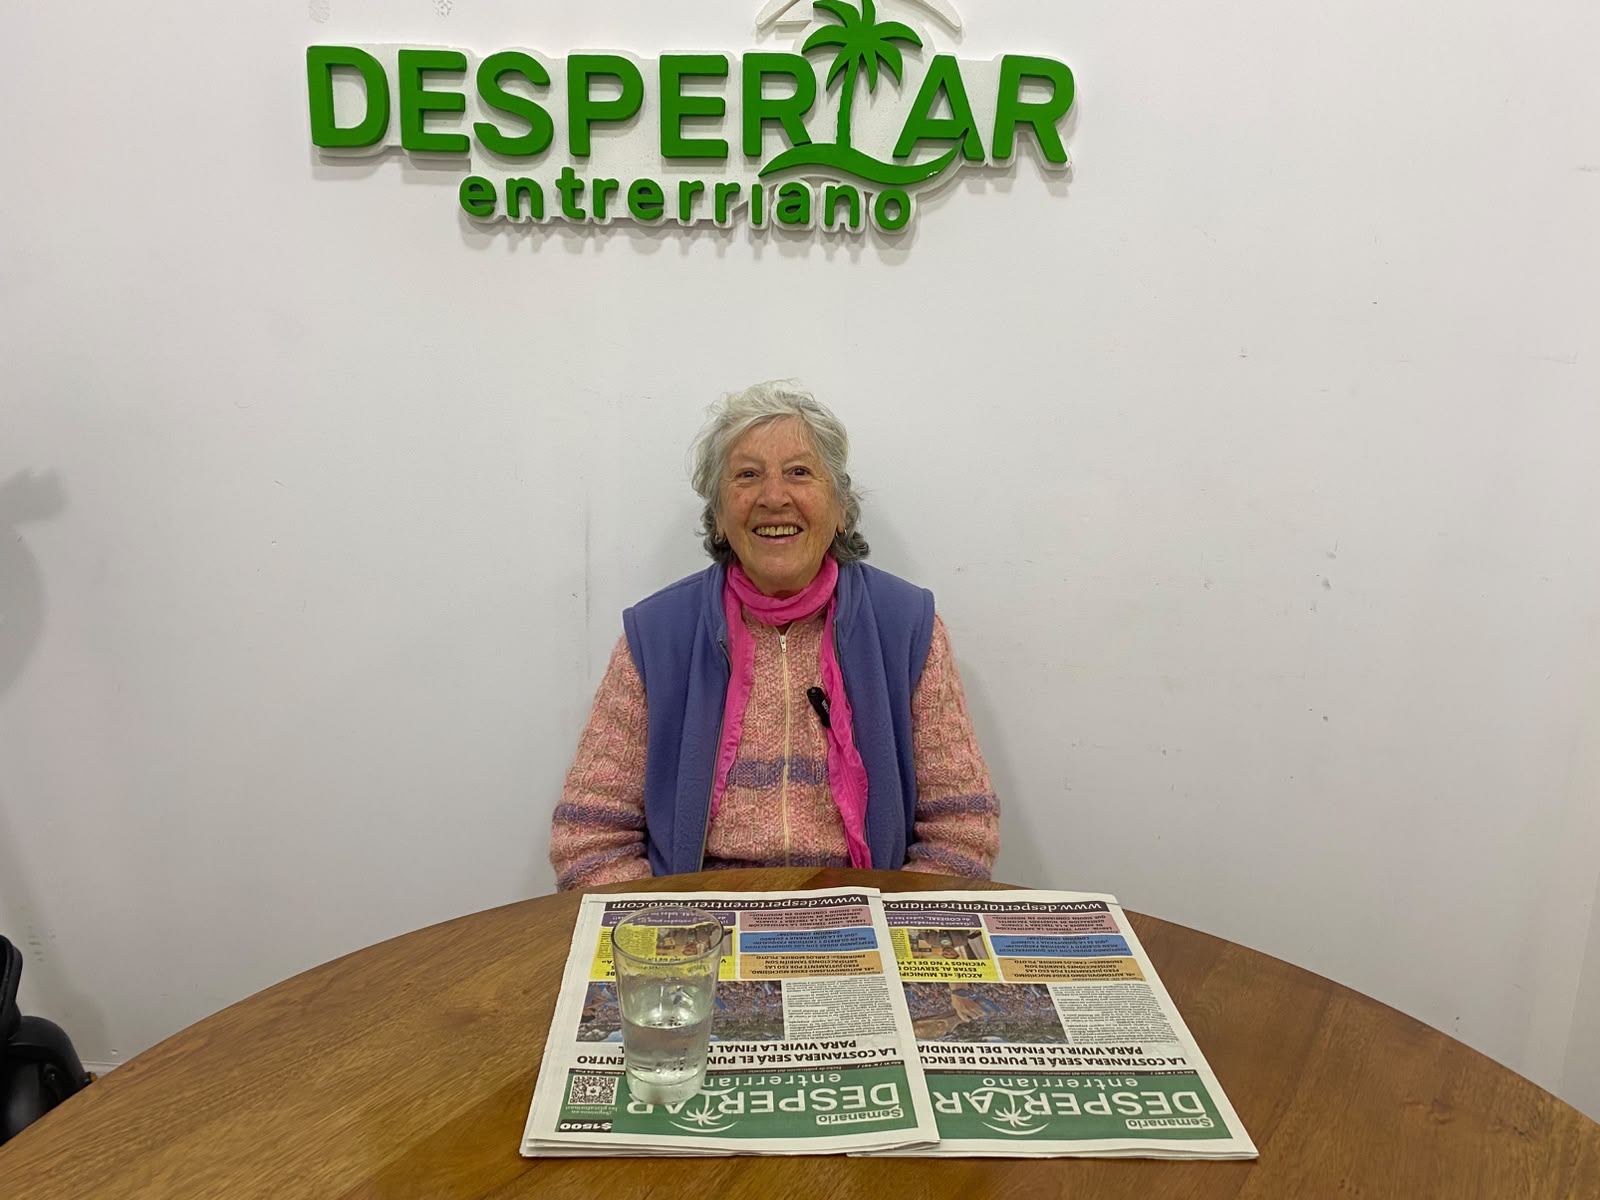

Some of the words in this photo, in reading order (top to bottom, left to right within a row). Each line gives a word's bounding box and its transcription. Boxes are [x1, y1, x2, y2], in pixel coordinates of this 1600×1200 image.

[458, 166, 911, 231] entrerriano
[716, 1044, 757, 1053] FINAL
[760, 1044, 778, 1052] LA
[780, 1042, 818, 1051] VIVIR
[820, 1040, 856, 1050] PARA
[878, 1048, 896, 1056] LA
[1003, 1046, 1046, 1054] FINAL
[1066, 1047, 1106, 1055] VIVIR
[1105, 1046, 1143, 1055] PARA
[738, 1055, 754, 1064] EL
[756, 1054, 792, 1065] SERÁ
[794, 1050, 876, 1062] COSTANERA
[958, 1056, 976, 1064] DE
[979, 1056, 1028, 1065] PUNTO
[1029, 1057, 1046, 1066] EL
[1046, 1057, 1082, 1068] SERÁ
[1083, 1058, 1166, 1066] COSTANERA
[1166, 1057, 1187, 1065] LA
[982, 1078, 1139, 1090] entrerriano
[818, 1109, 901, 1124] Semanario
[1128, 1118, 1210, 1128] Semanario
